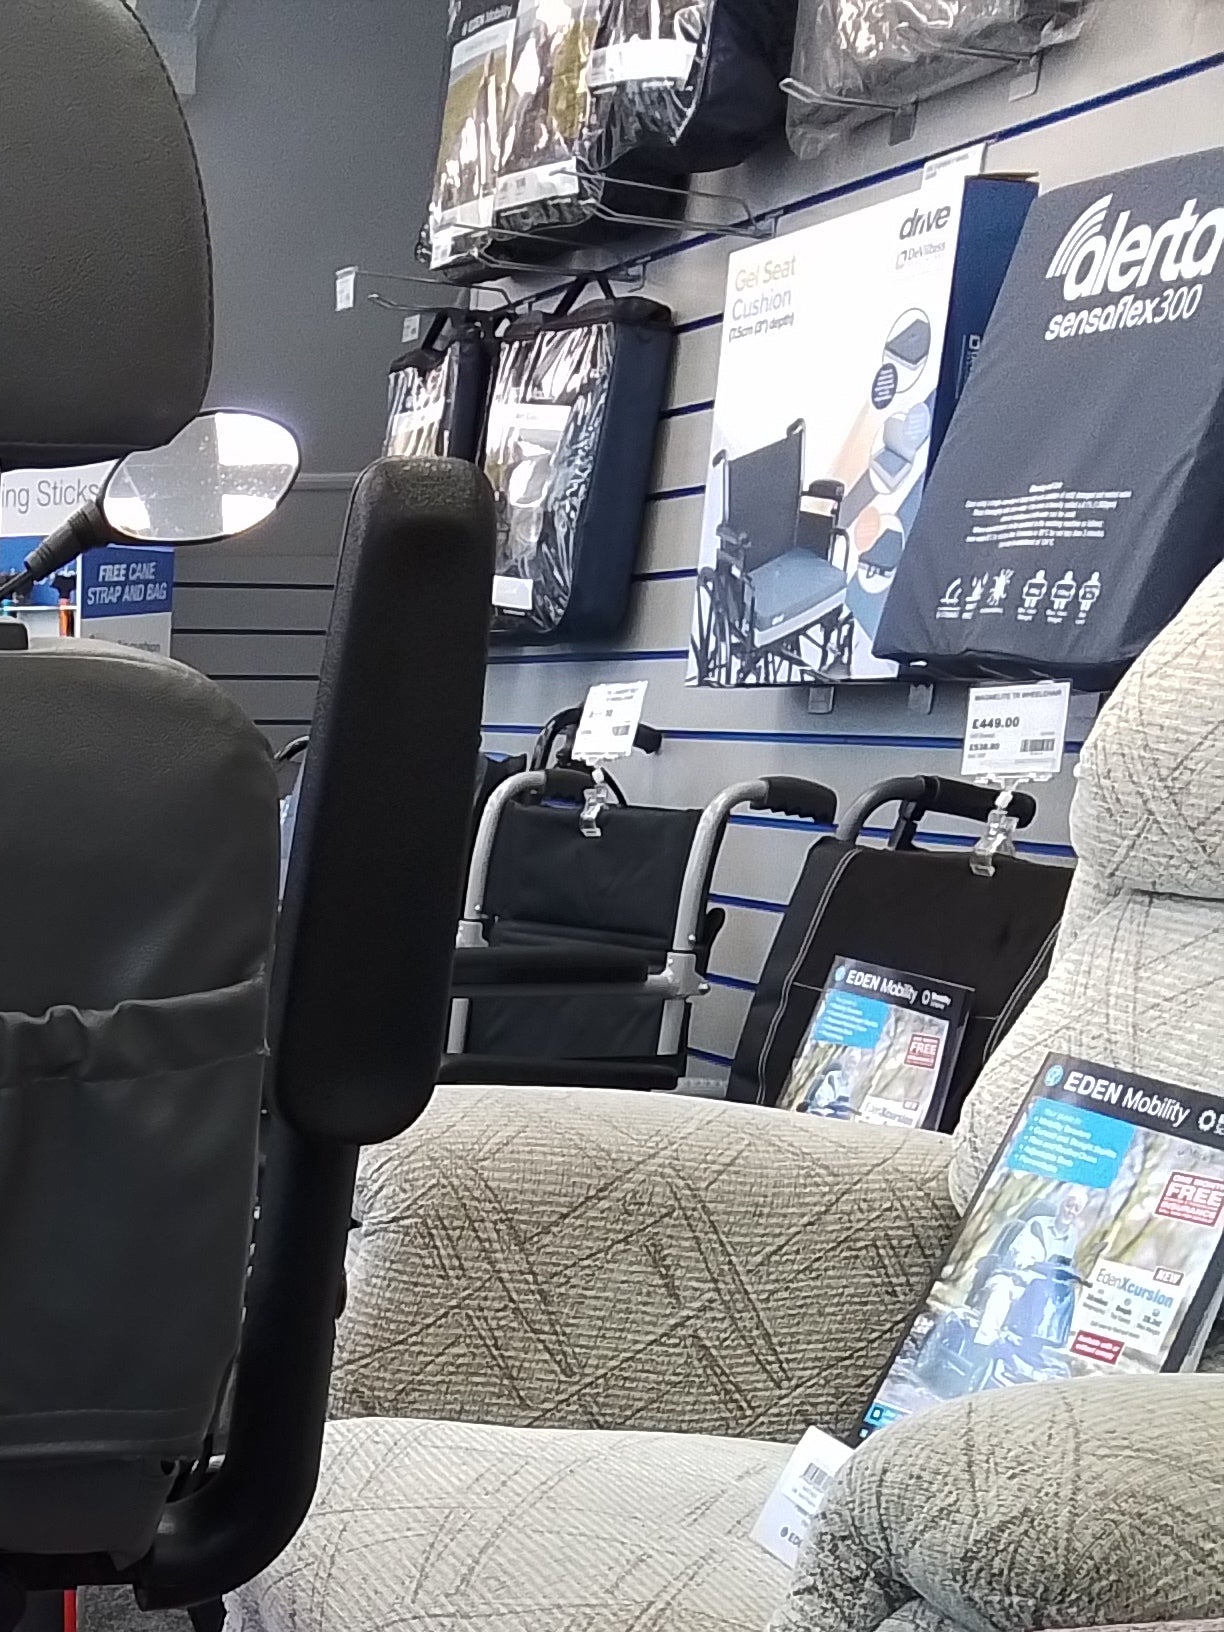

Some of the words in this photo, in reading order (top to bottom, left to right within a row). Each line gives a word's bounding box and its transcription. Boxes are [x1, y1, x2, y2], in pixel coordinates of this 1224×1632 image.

[899, 206, 951, 240] drive
[735, 264, 760, 292] Gel
[763, 254, 796, 284] Seat
[732, 288, 791, 321] Cushion
[37, 478, 100, 507] Sticks
[99, 564, 127, 582] FREE
[129, 561, 157, 581] CANE
[87, 586, 121, 605] STRAP
[122, 584, 145, 603] AND
[146, 582, 168, 601] BAG
[972, 716, 1020, 729] £449.00
[846, 969, 881, 993] EDEN
[880, 977, 918, 1005] Mobility
[909, 1042, 937, 1056] FREE
[1063, 1071, 1123, 1105] EDEN
[1121, 1087, 1190, 1128] Mobility
[1166, 1181, 1224, 1208] FREE
[1156, 1269, 1179, 1284] NEW
